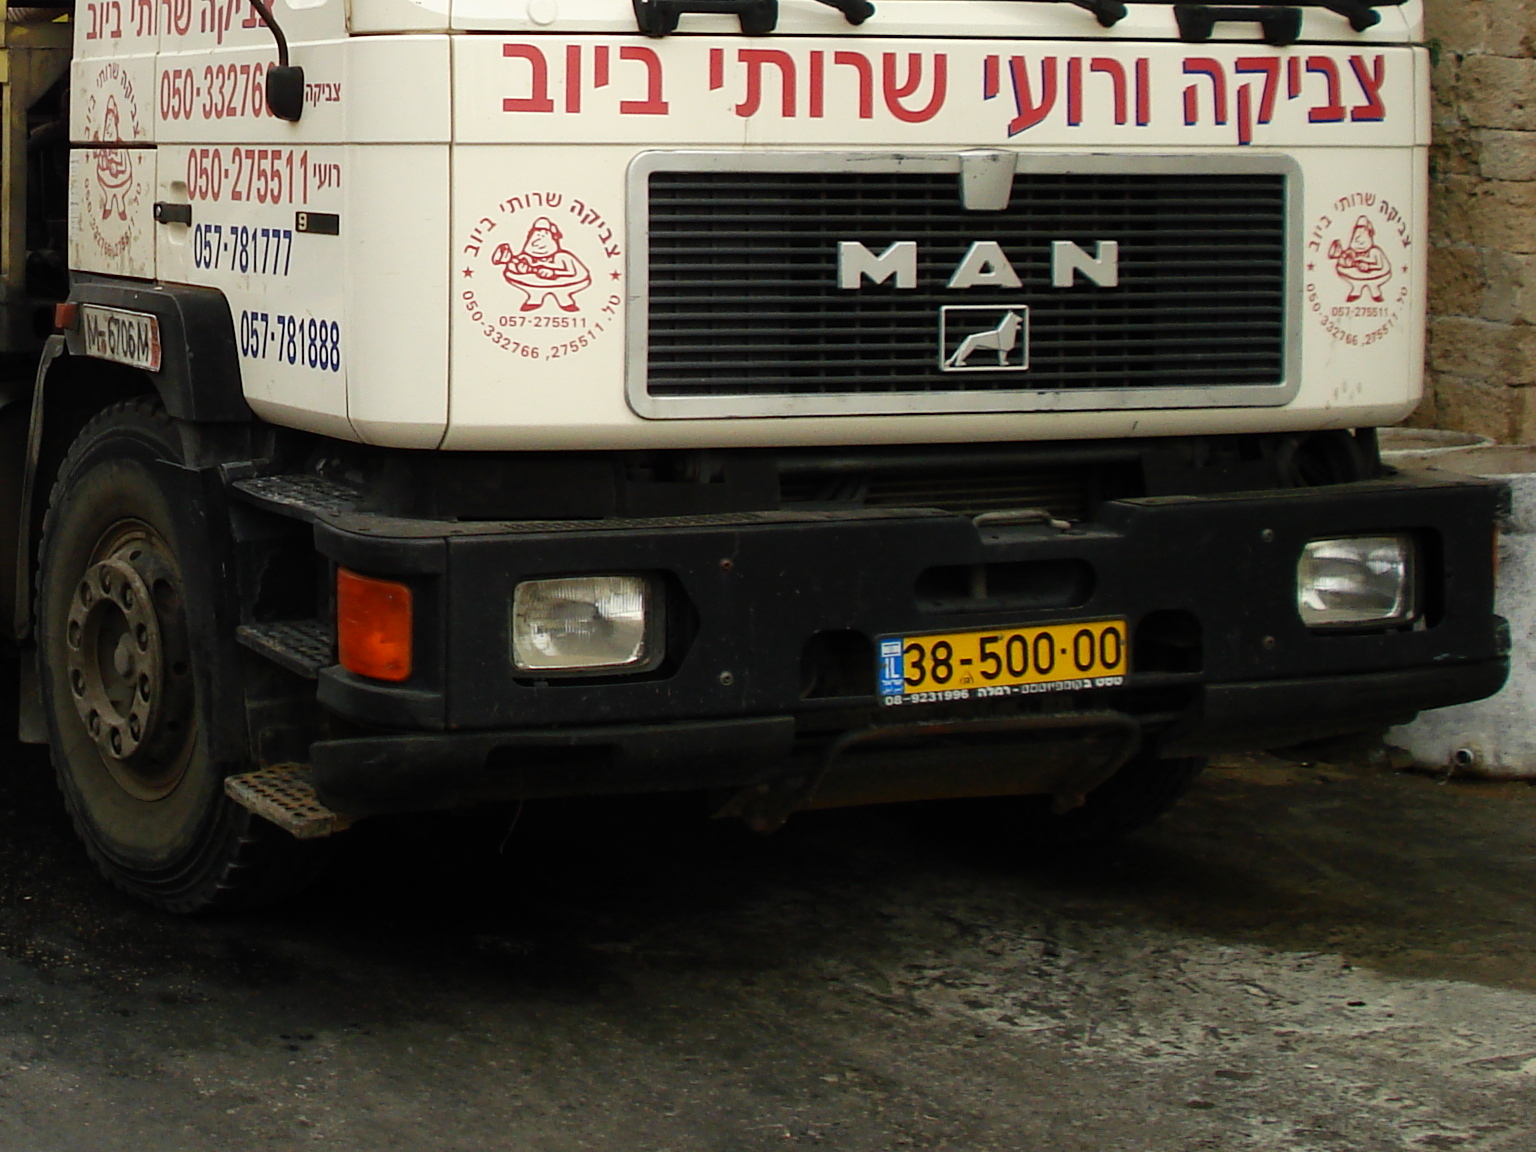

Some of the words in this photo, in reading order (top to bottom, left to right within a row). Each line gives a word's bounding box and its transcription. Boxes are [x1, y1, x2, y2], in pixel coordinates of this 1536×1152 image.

[86, 0, 122, 40] ביוב
[305, 83, 341, 107] צביקה
[502, 43, 669, 115] ביוב
[709, 47, 947, 123] שרותי
[984, 54, 1150, 138] ורועי
[1182, 54, 1385, 146] צביקה
[187, 147, 308, 205] 050-275511
[313, 163, 341, 190] רועי
[499, 192, 562, 214] שרותי
[1334, 192, 1376, 212] שרותי
[1379, 200, 1412, 248] צביקה
[194, 223, 292, 276] 057-781777
[464, 217, 497, 258] ביוב
[569, 199, 621, 259] צביקה
[1309, 215, 1332, 252] ביוב
[837, 241, 1118, 289] MAN
[240, 310, 340, 372] 057-781888
[462, 291, 539, 359] 050-332766
[499, 316, 587, 328] 057-275511
[885, 657, 899, 679] IL
